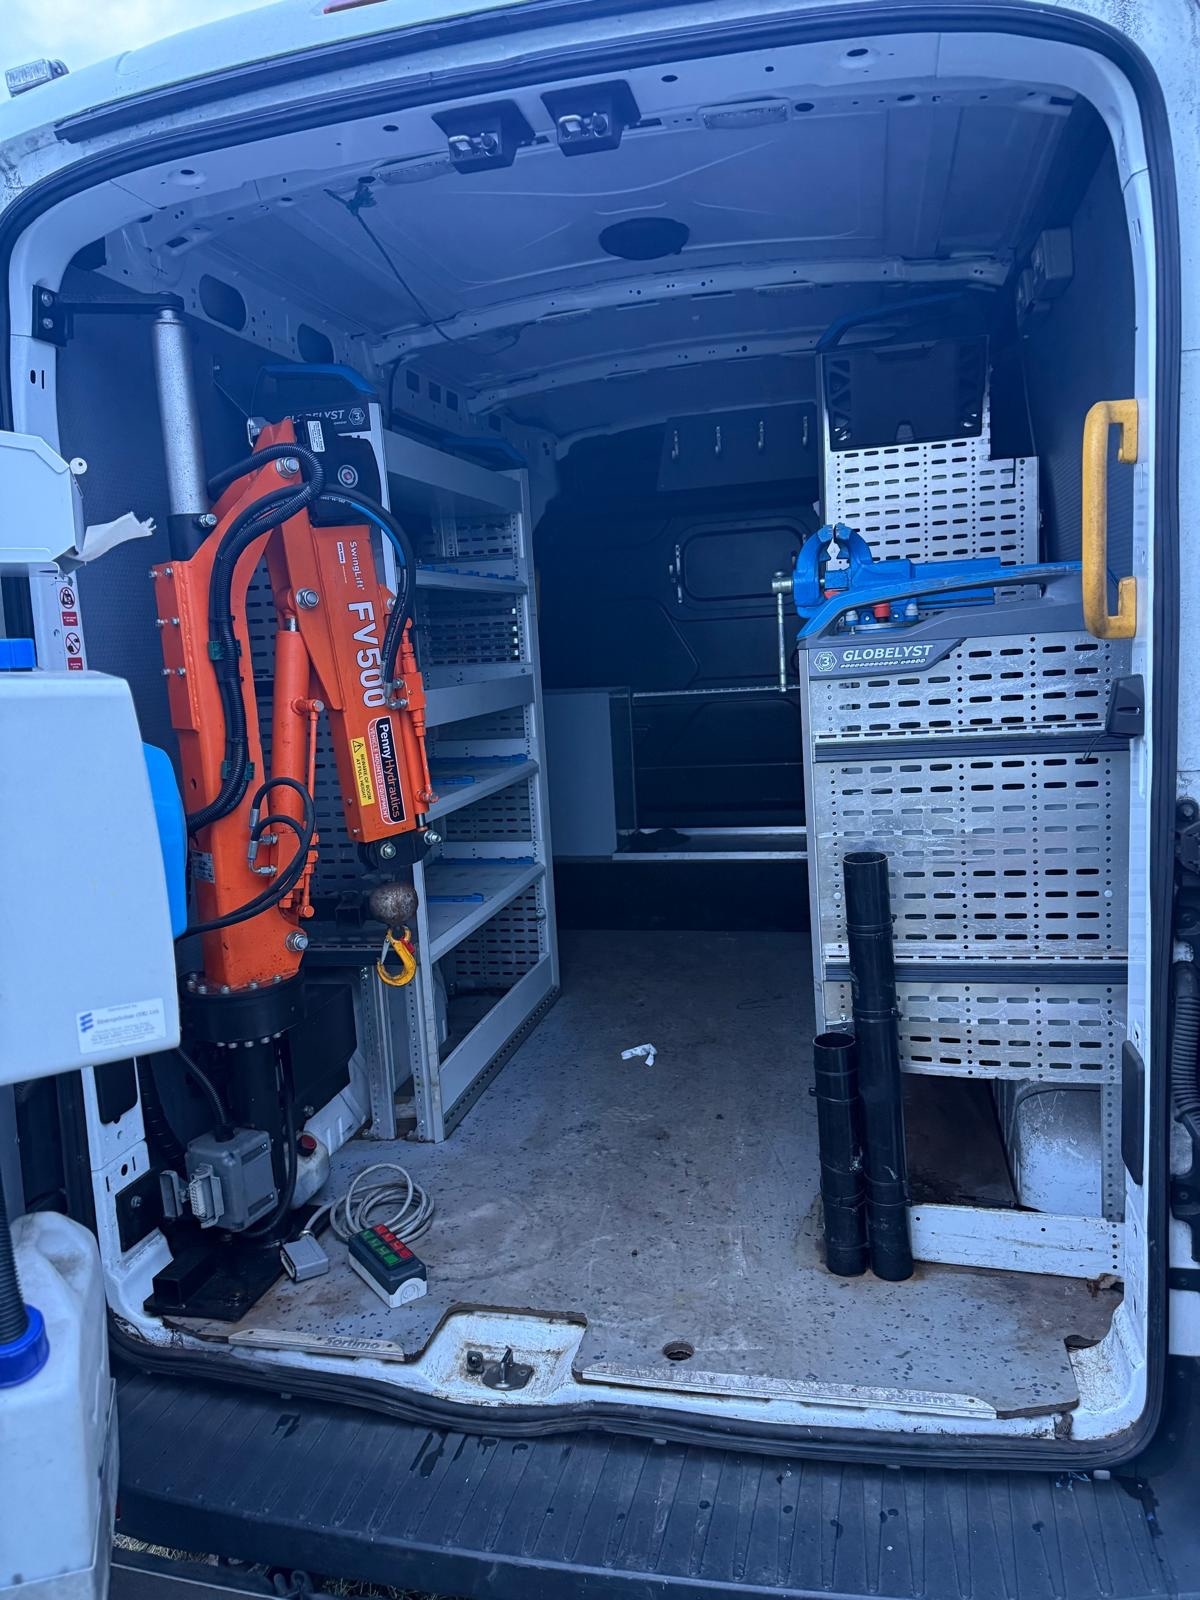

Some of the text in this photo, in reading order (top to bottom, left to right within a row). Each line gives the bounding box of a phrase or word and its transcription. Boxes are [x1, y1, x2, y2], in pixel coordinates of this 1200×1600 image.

[348, 601, 387, 708] FV500
[843, 644, 933, 661] GLOBELYST
[380, 724, 400, 818] Penny Hydraulics
[326, 1336, 380, 1349] Sortimo
